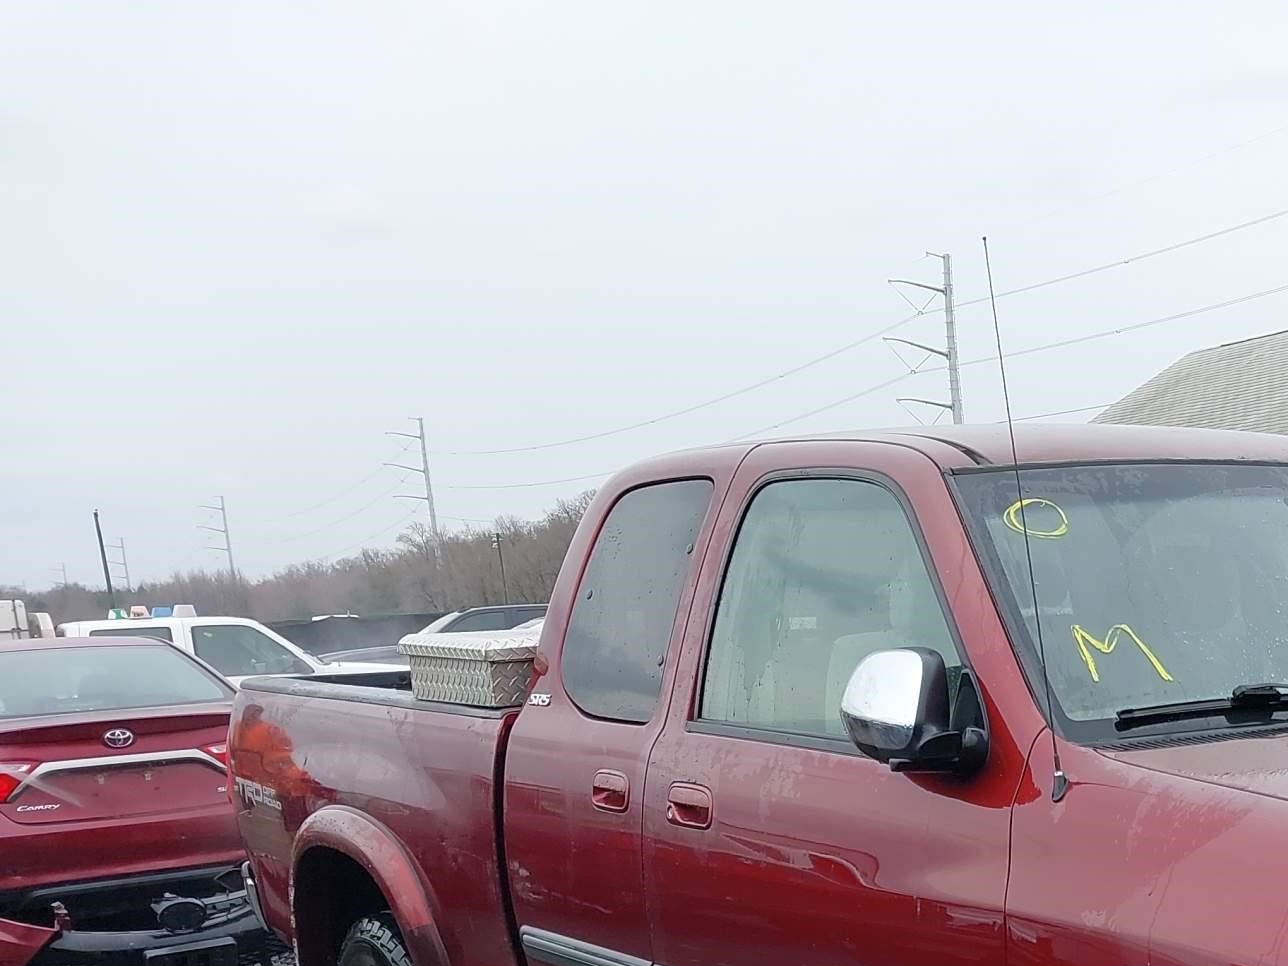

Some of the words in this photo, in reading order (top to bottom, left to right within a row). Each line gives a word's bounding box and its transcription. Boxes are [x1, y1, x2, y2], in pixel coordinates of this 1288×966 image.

[1071, 624, 1173, 682] M
[527, 693, 552, 706] SR5
[235, 776, 262, 807] TRD
